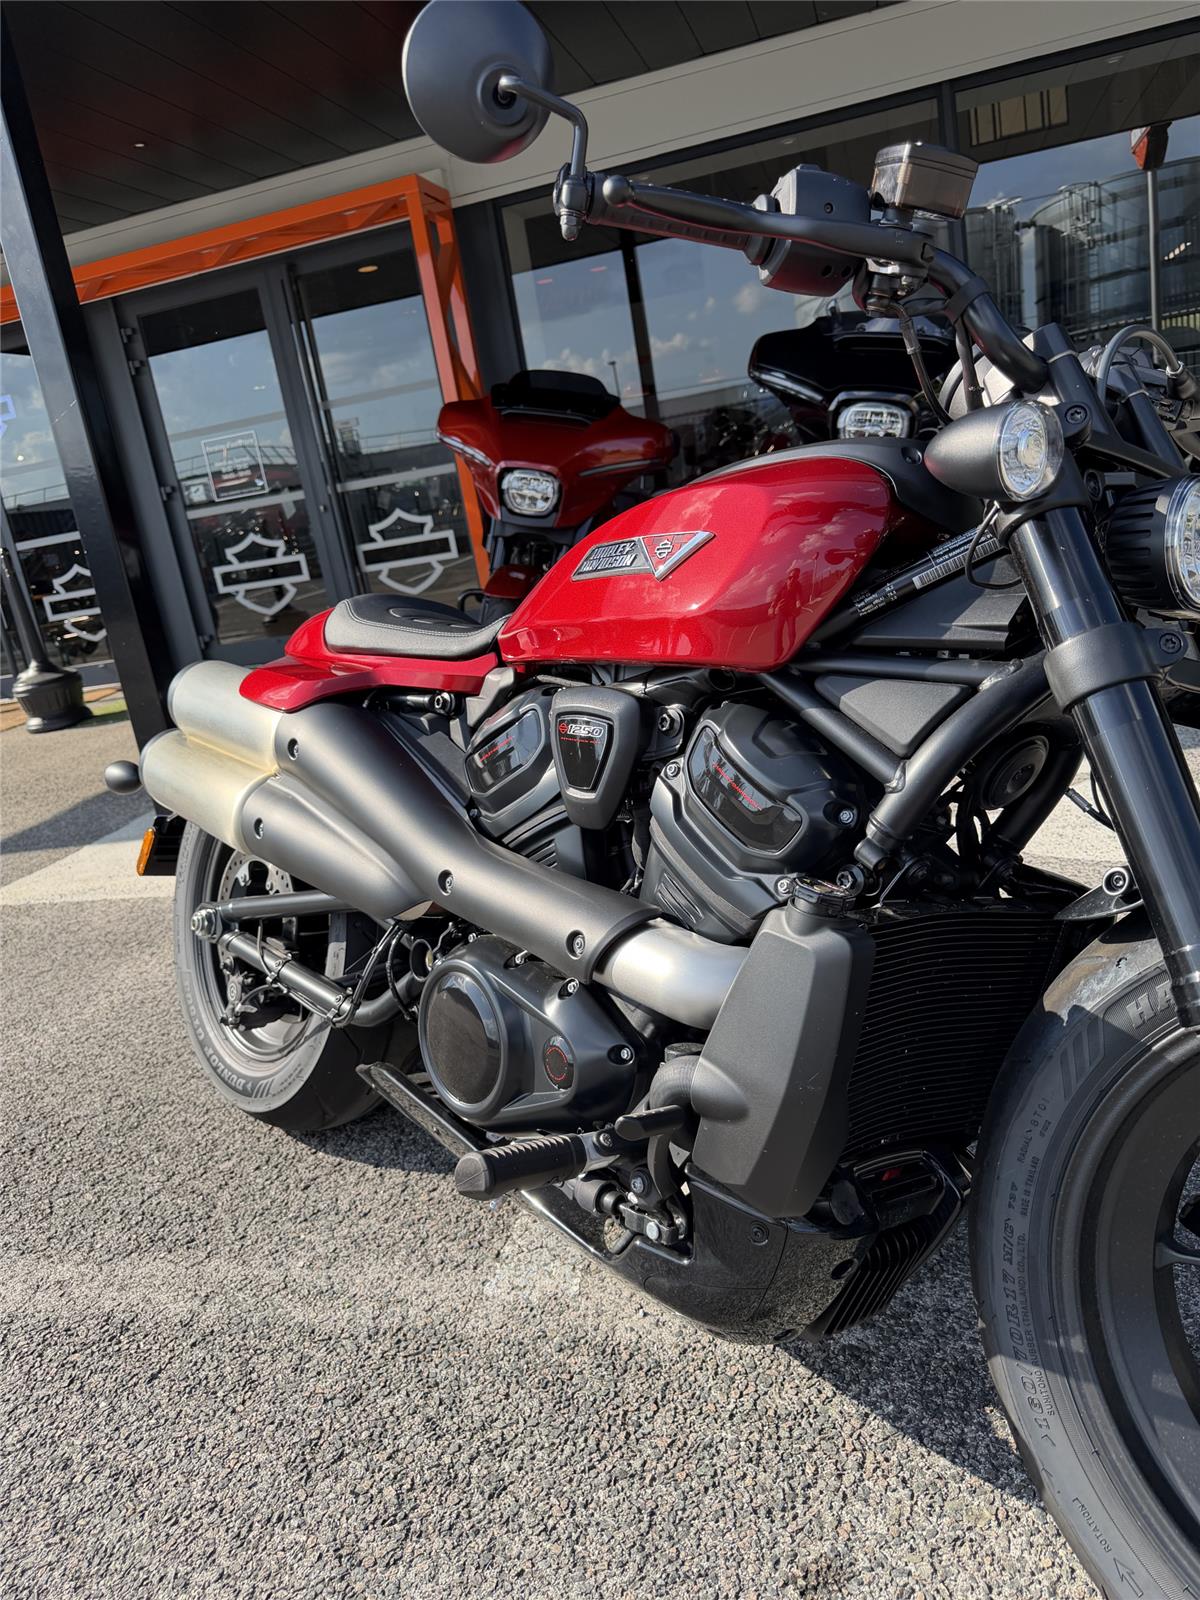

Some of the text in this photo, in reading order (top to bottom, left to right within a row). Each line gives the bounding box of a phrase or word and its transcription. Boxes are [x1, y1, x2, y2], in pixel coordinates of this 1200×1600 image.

[566, 723, 604, 738] 1250
[204, 1046, 247, 1091] DUNLOP
[1024, 1329, 1040, 1367] RUBBER
[1034, 1370, 1056, 1417] SUMITOMO
[1078, 1503, 1113, 1553] ROTATION
